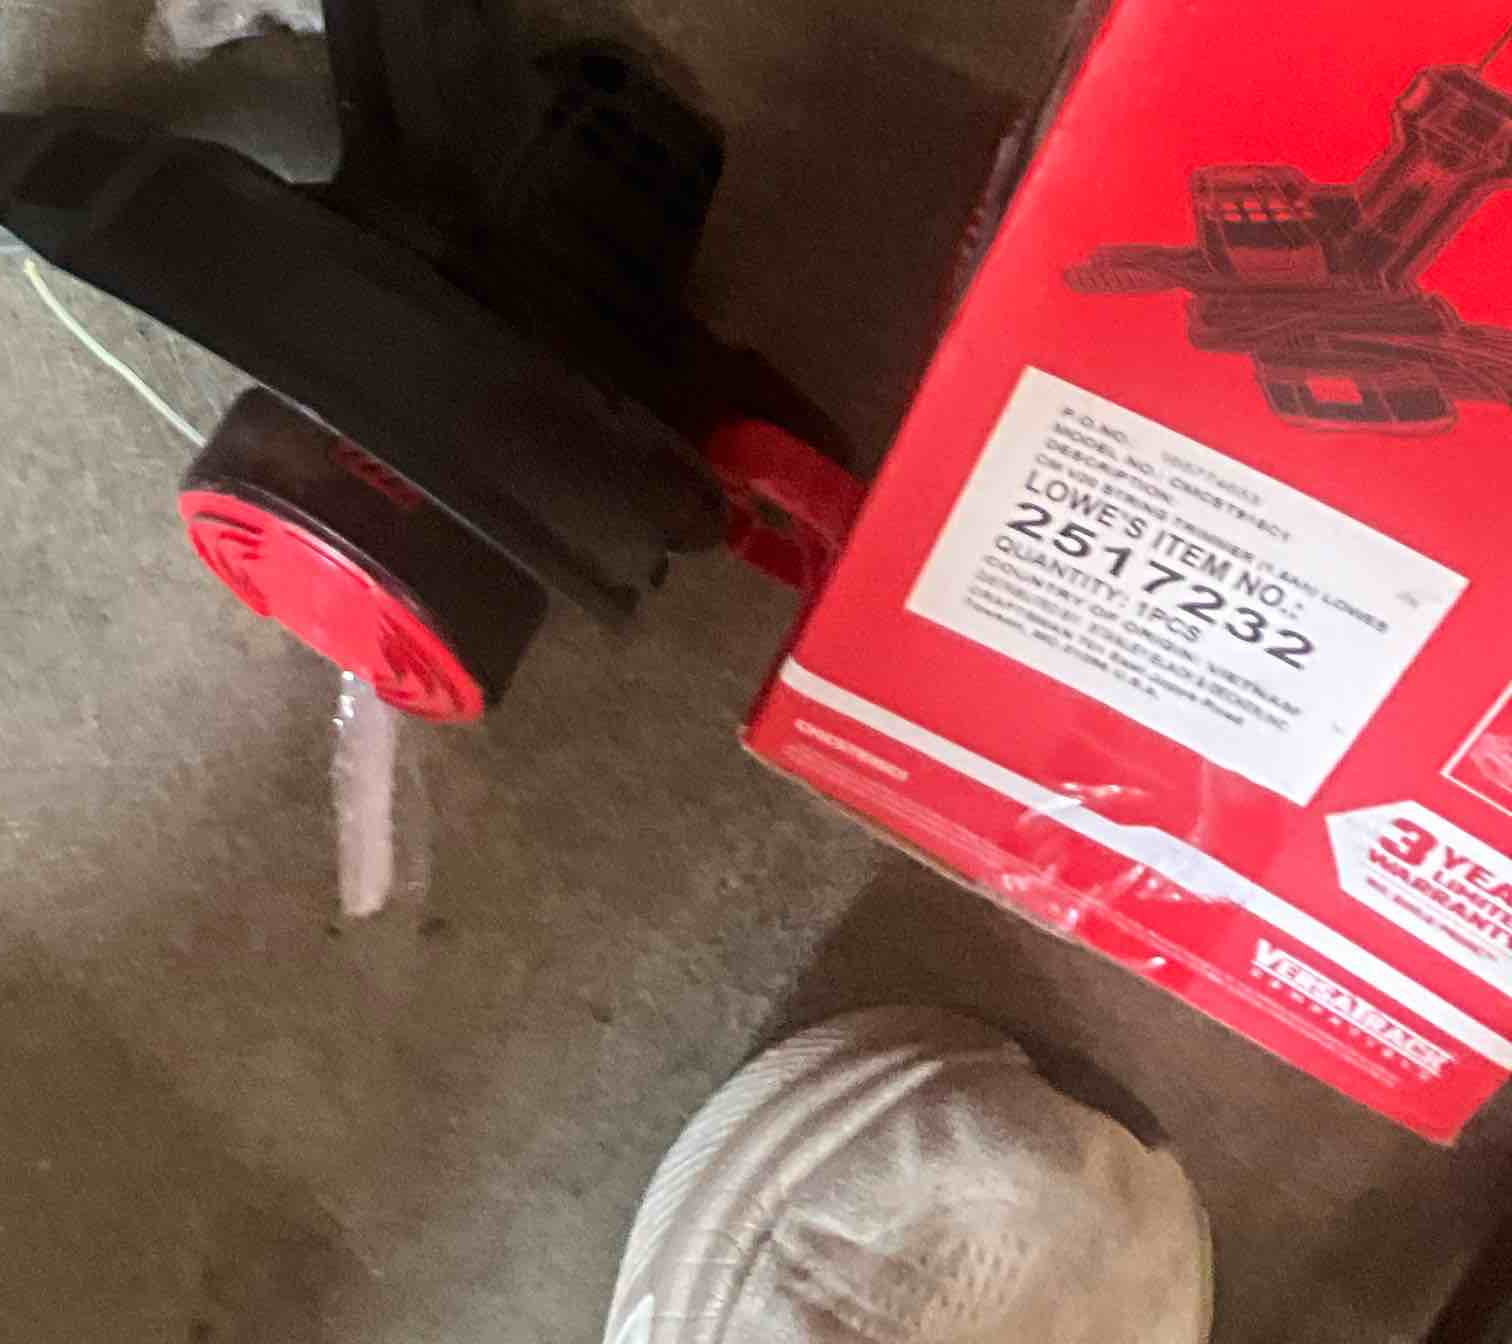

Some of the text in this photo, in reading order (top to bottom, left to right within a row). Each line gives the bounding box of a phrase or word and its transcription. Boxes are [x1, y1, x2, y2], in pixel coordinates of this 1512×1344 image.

[1053, 420, 1120, 459] MODEL
[994, 532, 1202, 642] QUANTITY: 1PCS
[1007, 501, 1315, 670] 2517232
[1024, 467, 1307, 619] LOWE'S ITEM NO.:
[984, 553, 1082, 608] COUNTRY
[1088, 603, 1118, 624] OF
[1204, 661, 1302, 717] VIETNAM
[1377, 818, 1438, 865] 3
